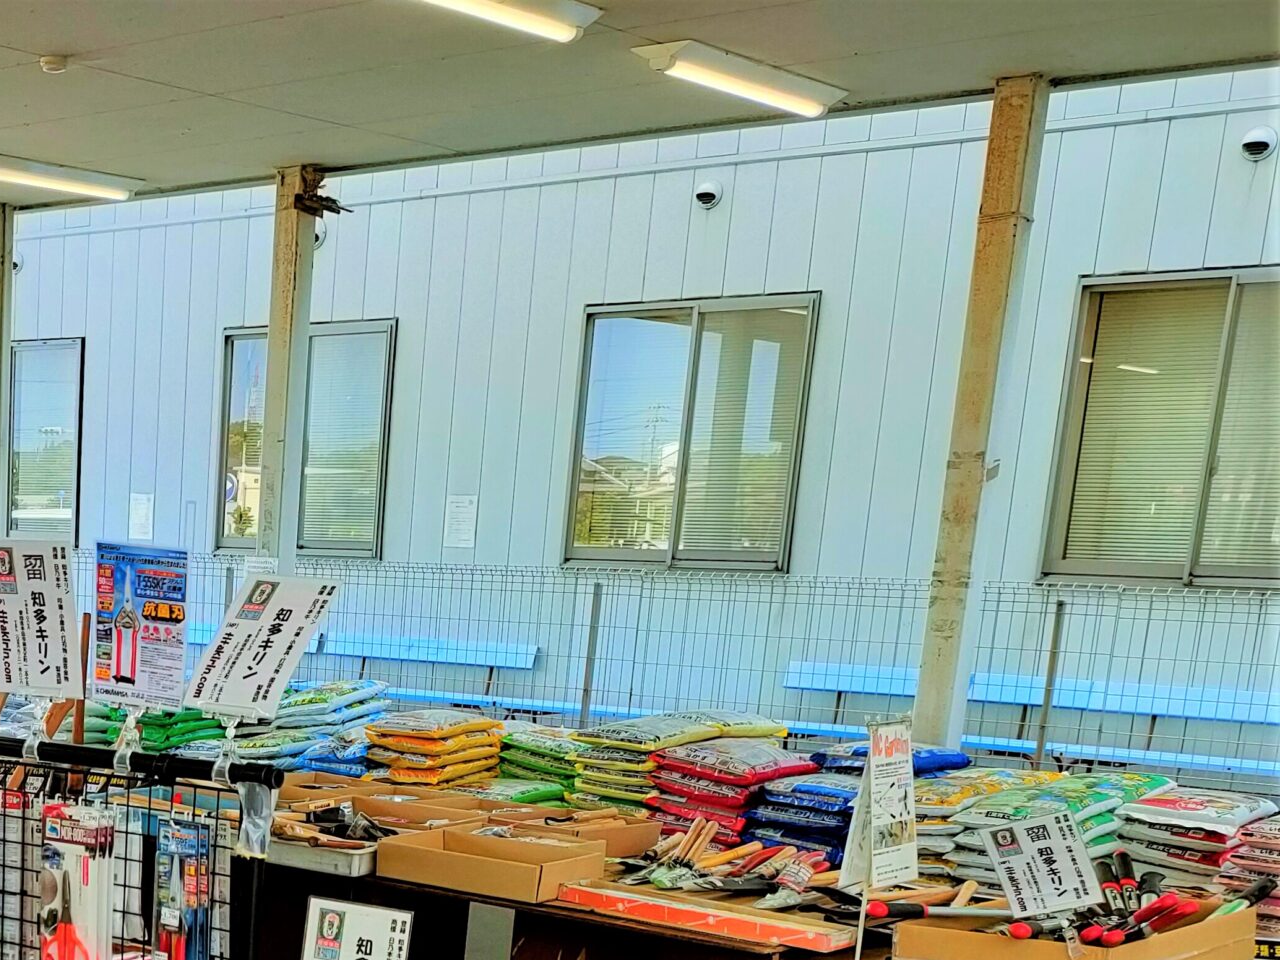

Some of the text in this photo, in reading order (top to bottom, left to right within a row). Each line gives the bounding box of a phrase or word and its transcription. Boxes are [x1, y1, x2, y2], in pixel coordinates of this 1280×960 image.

[31, 591, 50, 674] 知多キリン
[242, 607, 293, 680] 知多キリン
[1037, 846, 1068, 897] 知多キリン
